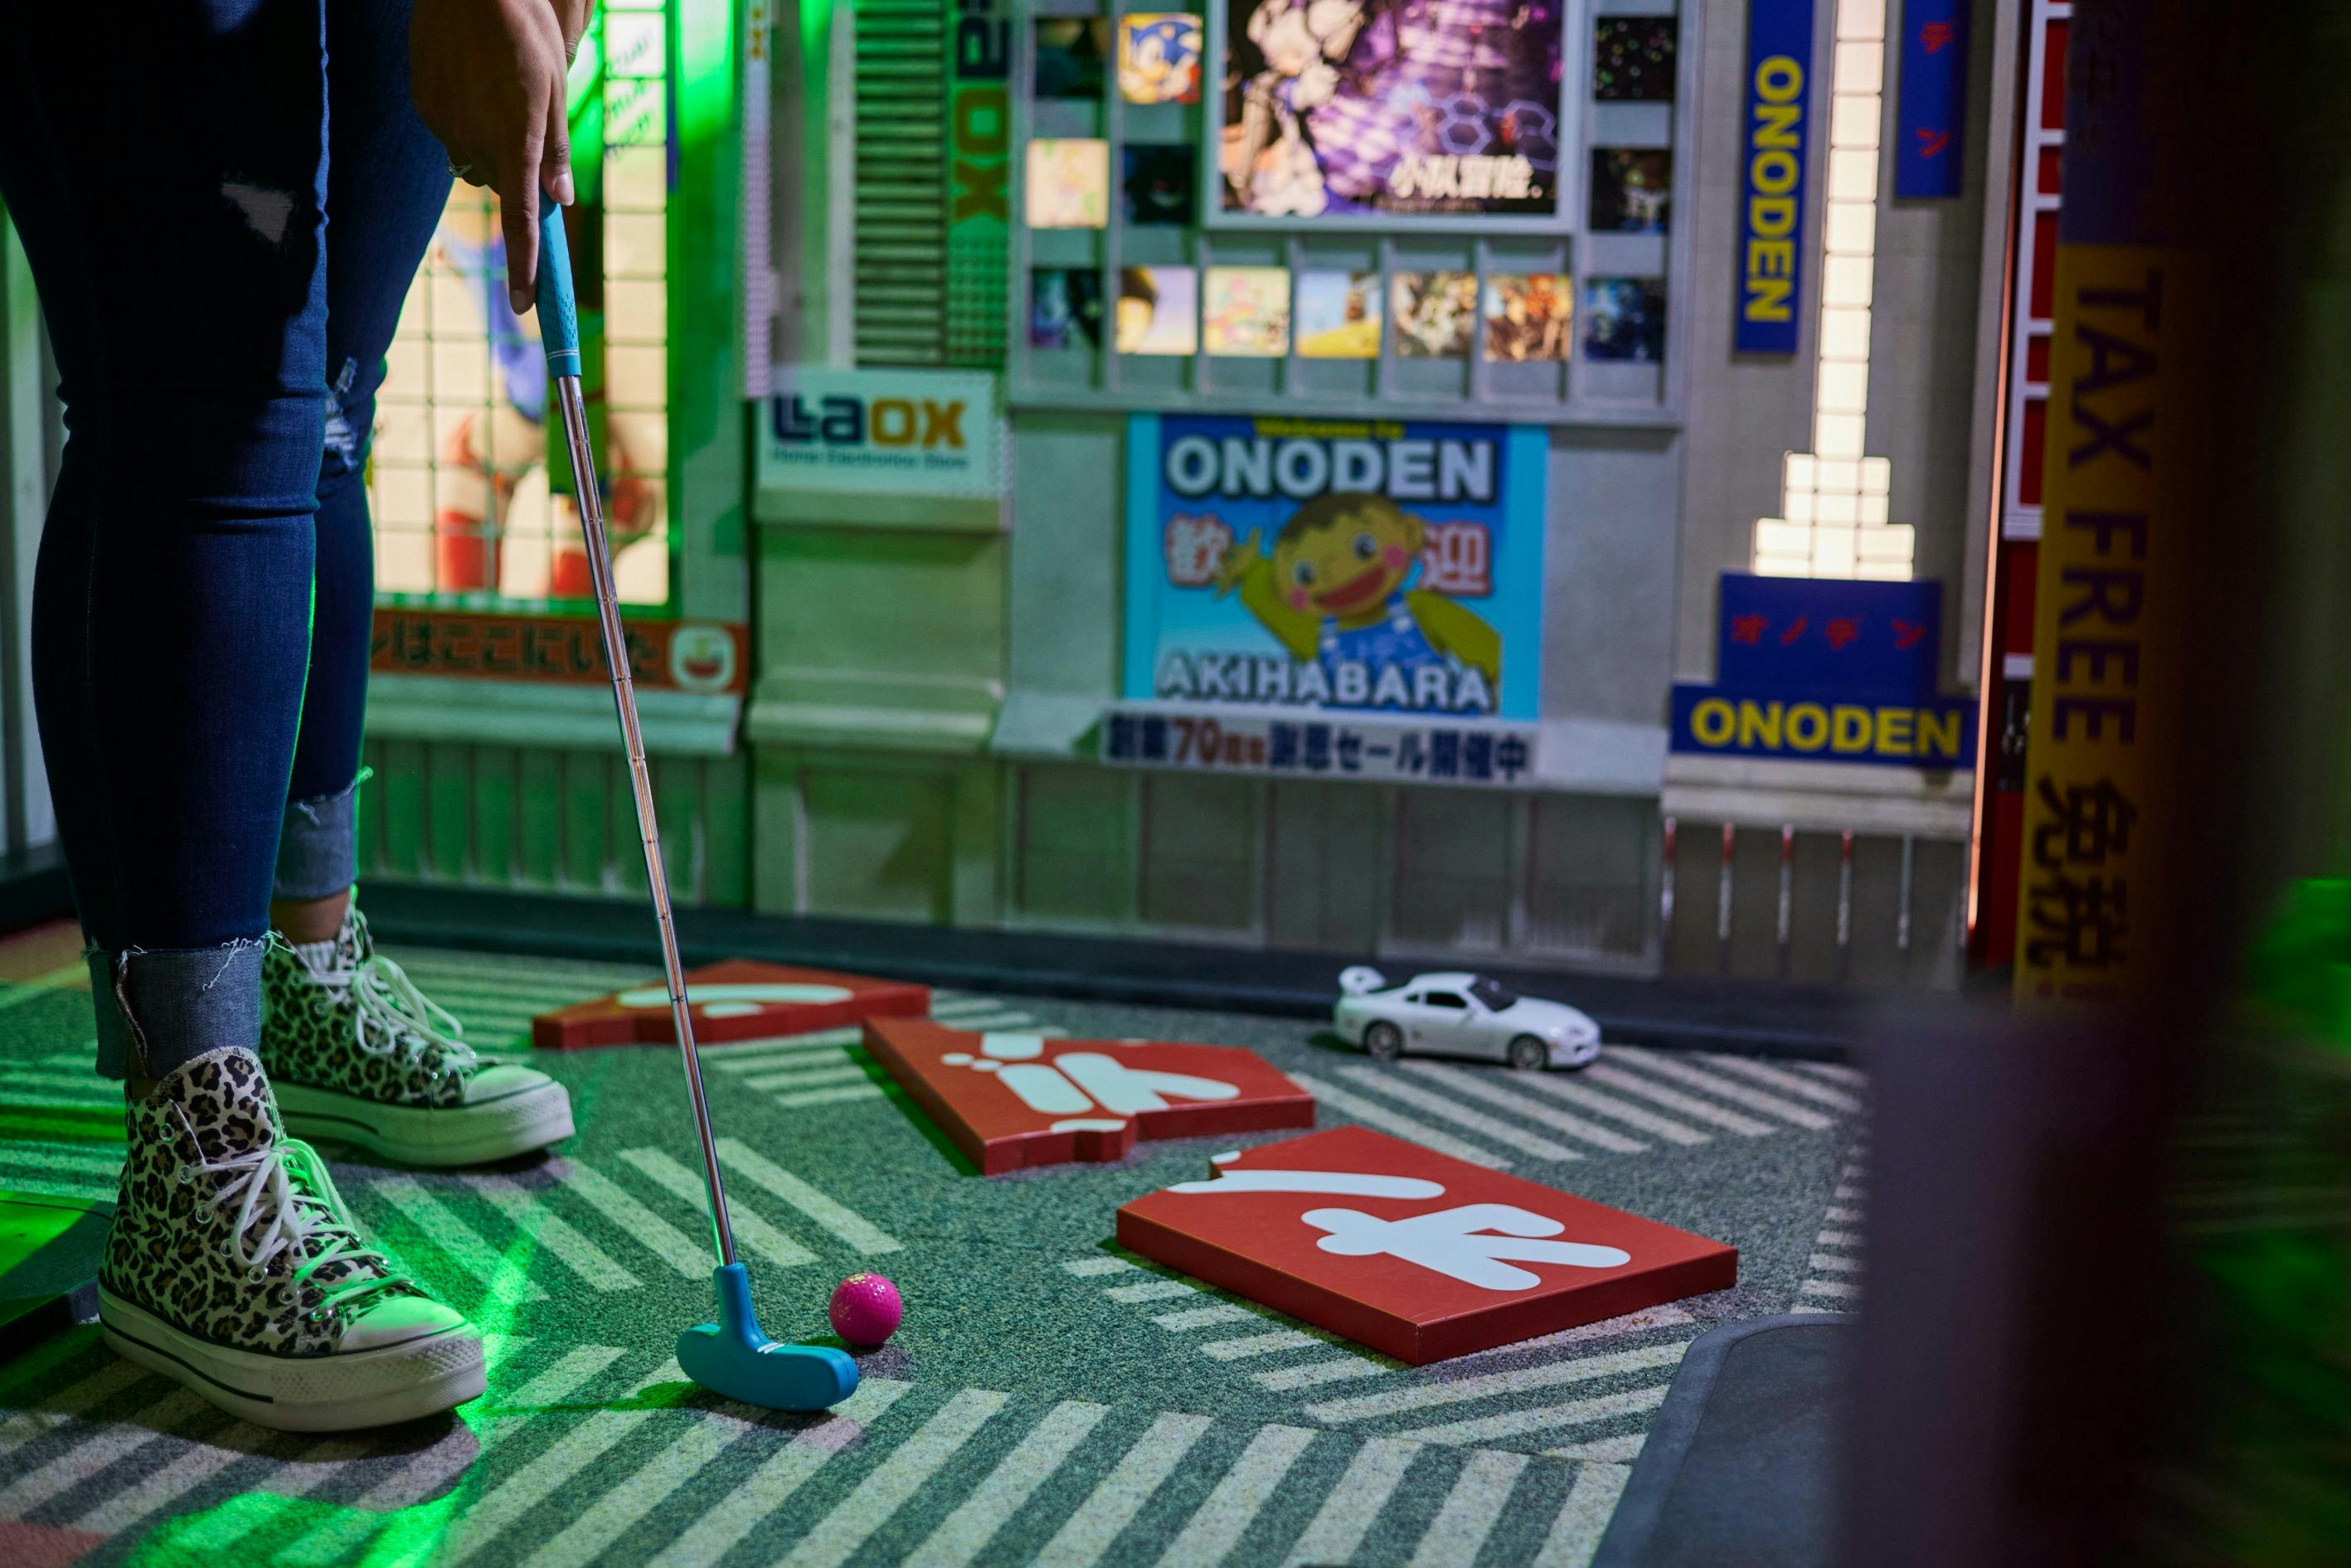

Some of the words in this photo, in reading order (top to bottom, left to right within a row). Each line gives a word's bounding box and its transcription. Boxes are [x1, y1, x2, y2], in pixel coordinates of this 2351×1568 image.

[954, 0, 1008, 222] aox
[1745, 55, 1803, 322] ONODEN
[773, 394, 965, 450] Laox
[2070, 269, 2162, 472] TAX
[1164, 433, 1495, 500] ONODEN
[1155, 653, 1492, 712] AKIHABARA
[2053, 510, 2147, 742] FREE
[1689, 697, 1961, 758] ONODEN
